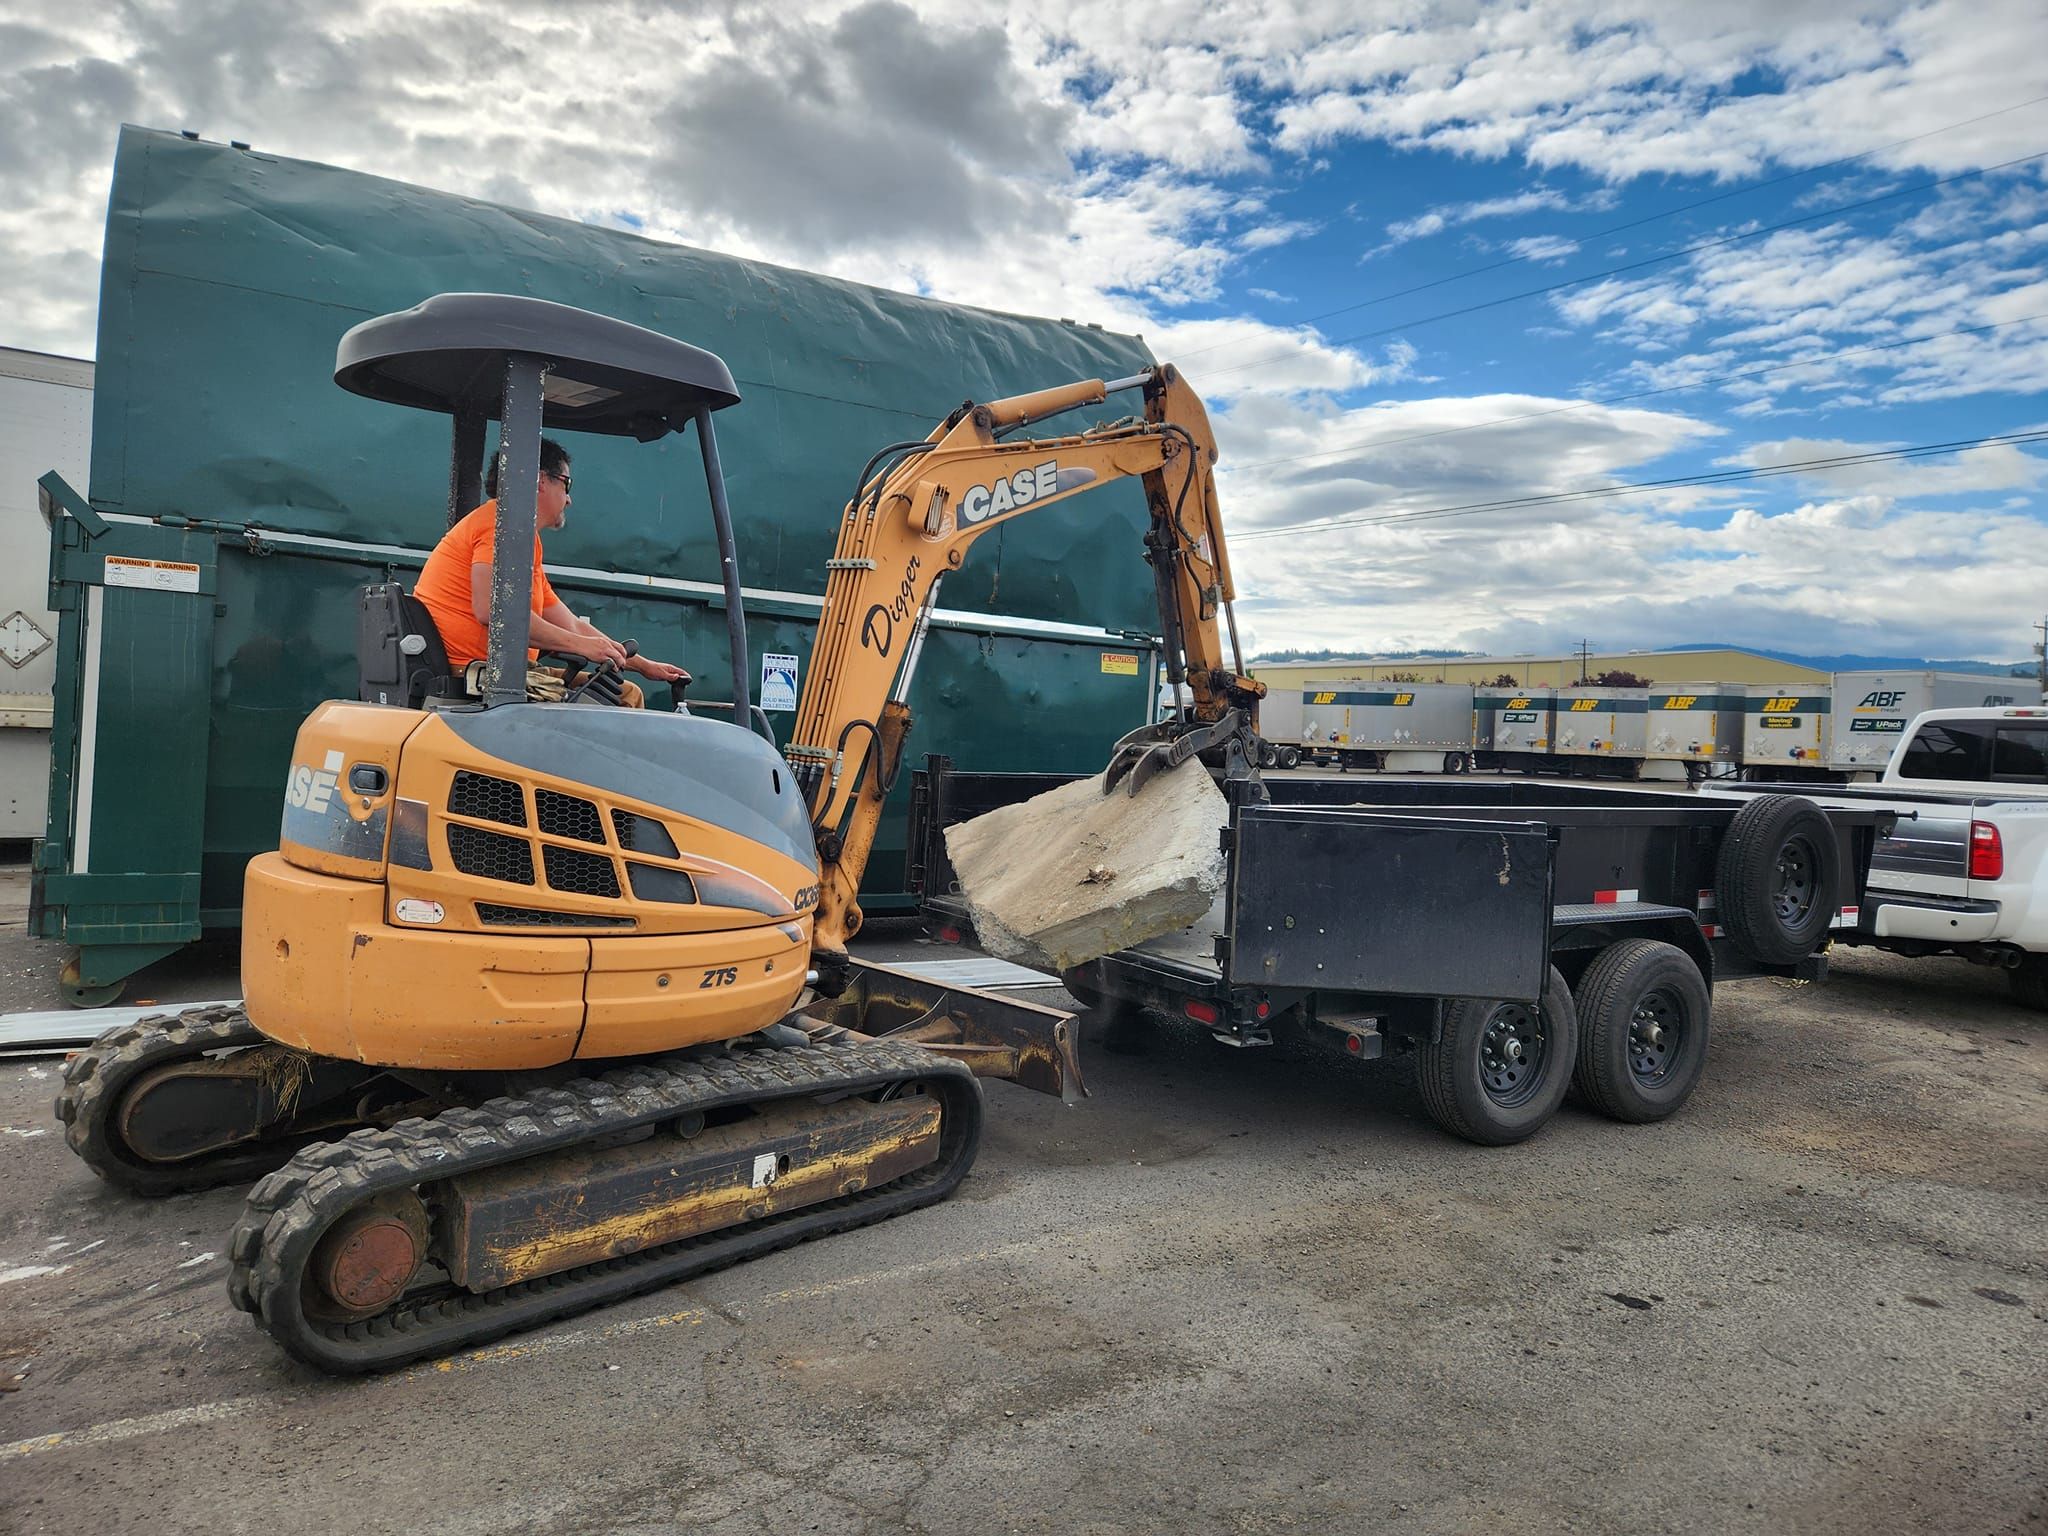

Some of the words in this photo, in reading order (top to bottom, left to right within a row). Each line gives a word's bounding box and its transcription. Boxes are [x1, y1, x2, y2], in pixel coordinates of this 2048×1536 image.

[963, 460, 1057, 522] CASE
[113, 558, 150, 567] WARNING
[160, 562, 197, 571] WARNING
[861, 554, 921, 658] Digger
[1110, 655, 1136, 663] CAUTION
[1313, 692, 1336, 704] ABF
[1393, 693, 1413, 705] ABF
[1506, 698, 1532, 709] ABF
[1663, 696, 1697, 710] ABF
[1858, 691, 1906, 707] ABF
[1570, 699, 1599, 711] ABF
[1762, 698, 1799, 712] ABF
[699, 966, 738, 989] ZTS
